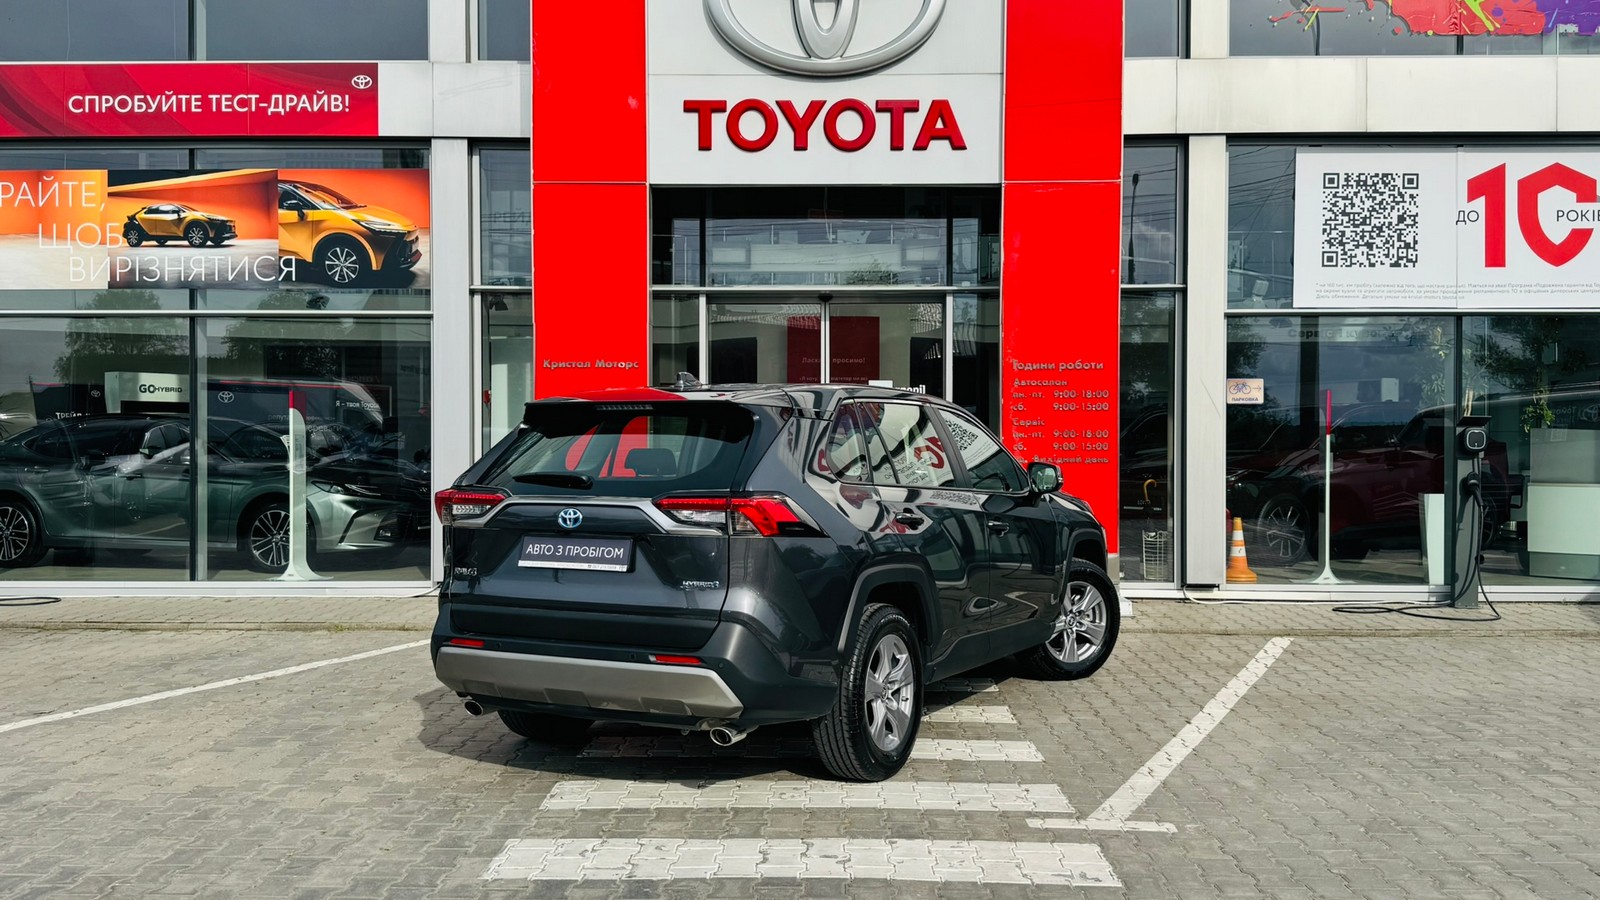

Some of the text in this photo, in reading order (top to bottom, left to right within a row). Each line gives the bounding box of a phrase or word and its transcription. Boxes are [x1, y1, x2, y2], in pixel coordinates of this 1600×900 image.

[68, 90, 350, 115] СПРОБУЙТЕ ТЕСТ-ДРАЙВ!
[683, 98, 968, 152] TOYOTA
[1455, 210, 1480, 225] ДО
[38, 222, 123, 253] ЩОБ
[70, 255, 296, 282] ВИРІЗНЯТИСЯ
[543, 359, 639, 370] Кристал Моторс
[1012, 360, 1104, 372] Години роботи
[1013, 378, 1068, 386] Автосалон
[525, 544, 554, 556] АВТО
[565, 545, 625, 559] ПРОБІГОМ
